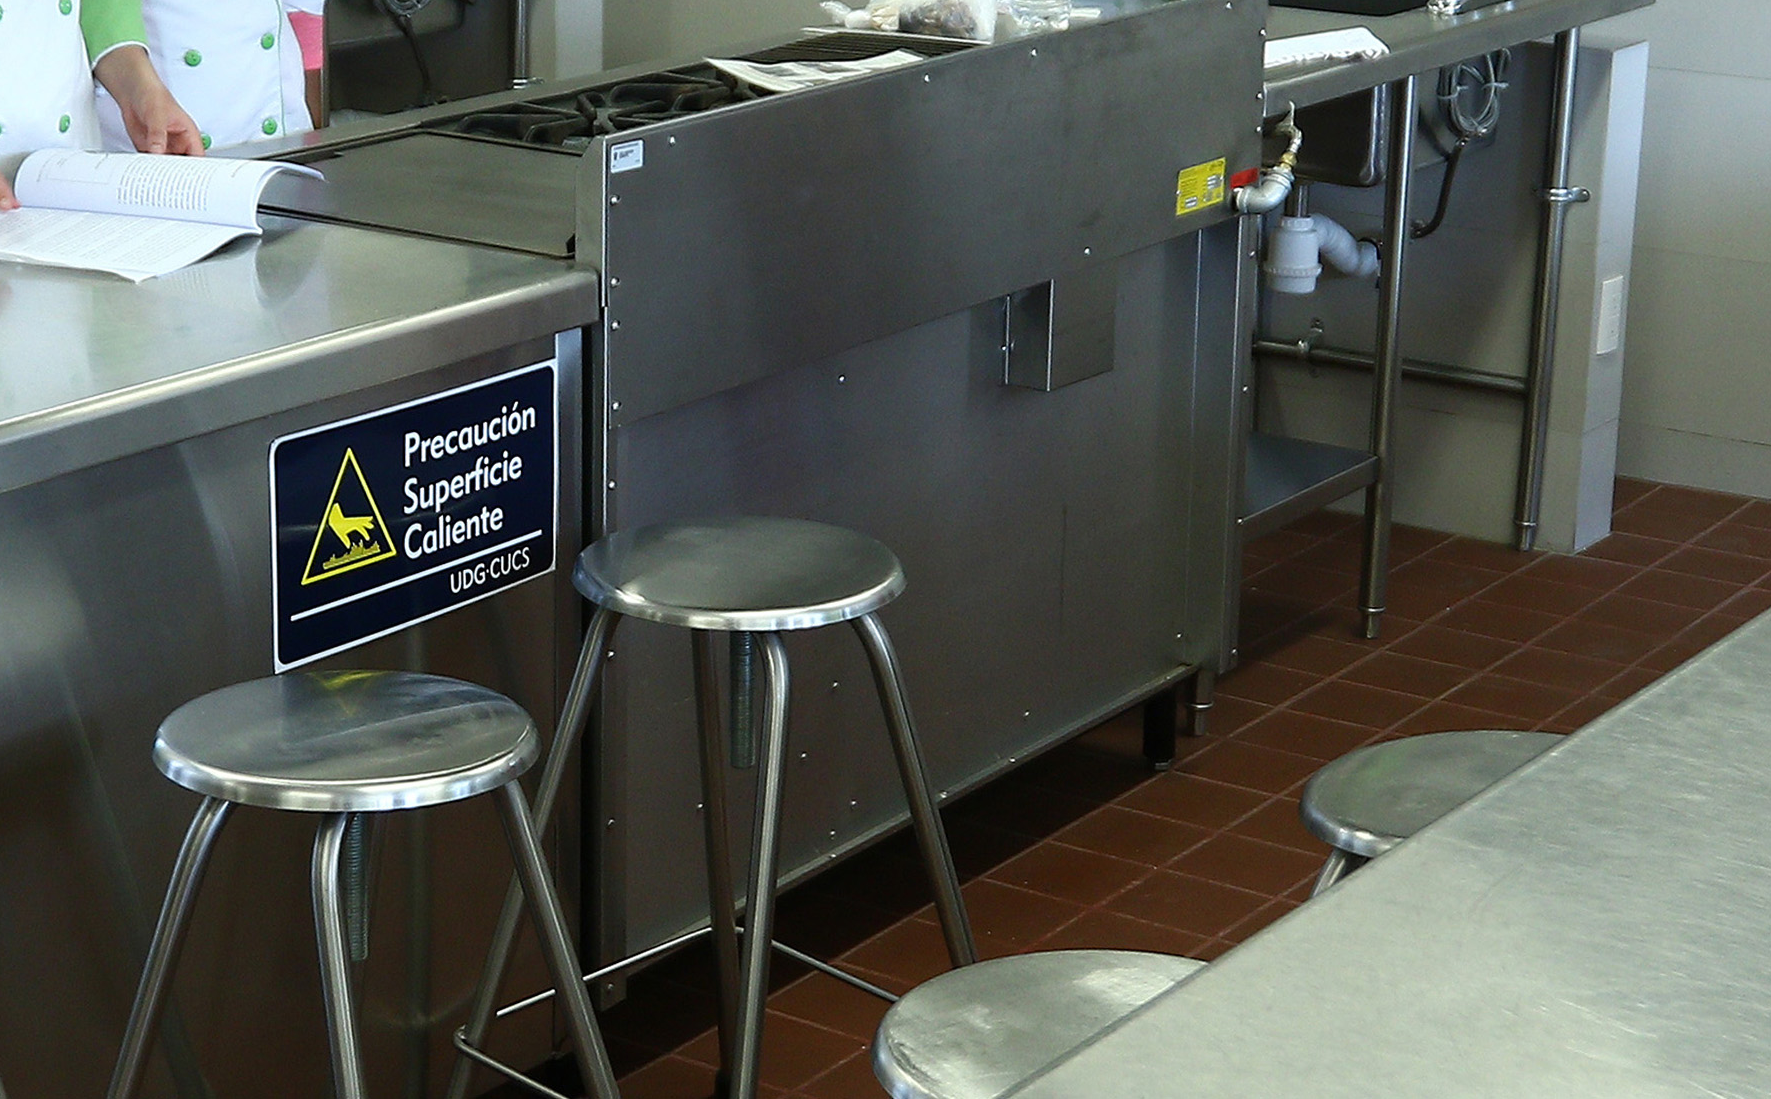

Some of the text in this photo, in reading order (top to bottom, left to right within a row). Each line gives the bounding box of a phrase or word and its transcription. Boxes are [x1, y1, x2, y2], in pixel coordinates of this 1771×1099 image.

[404, 400, 537, 468] Precaución
[403, 450, 523, 514] Superficie
[403, 506, 504, 560] Caliente
